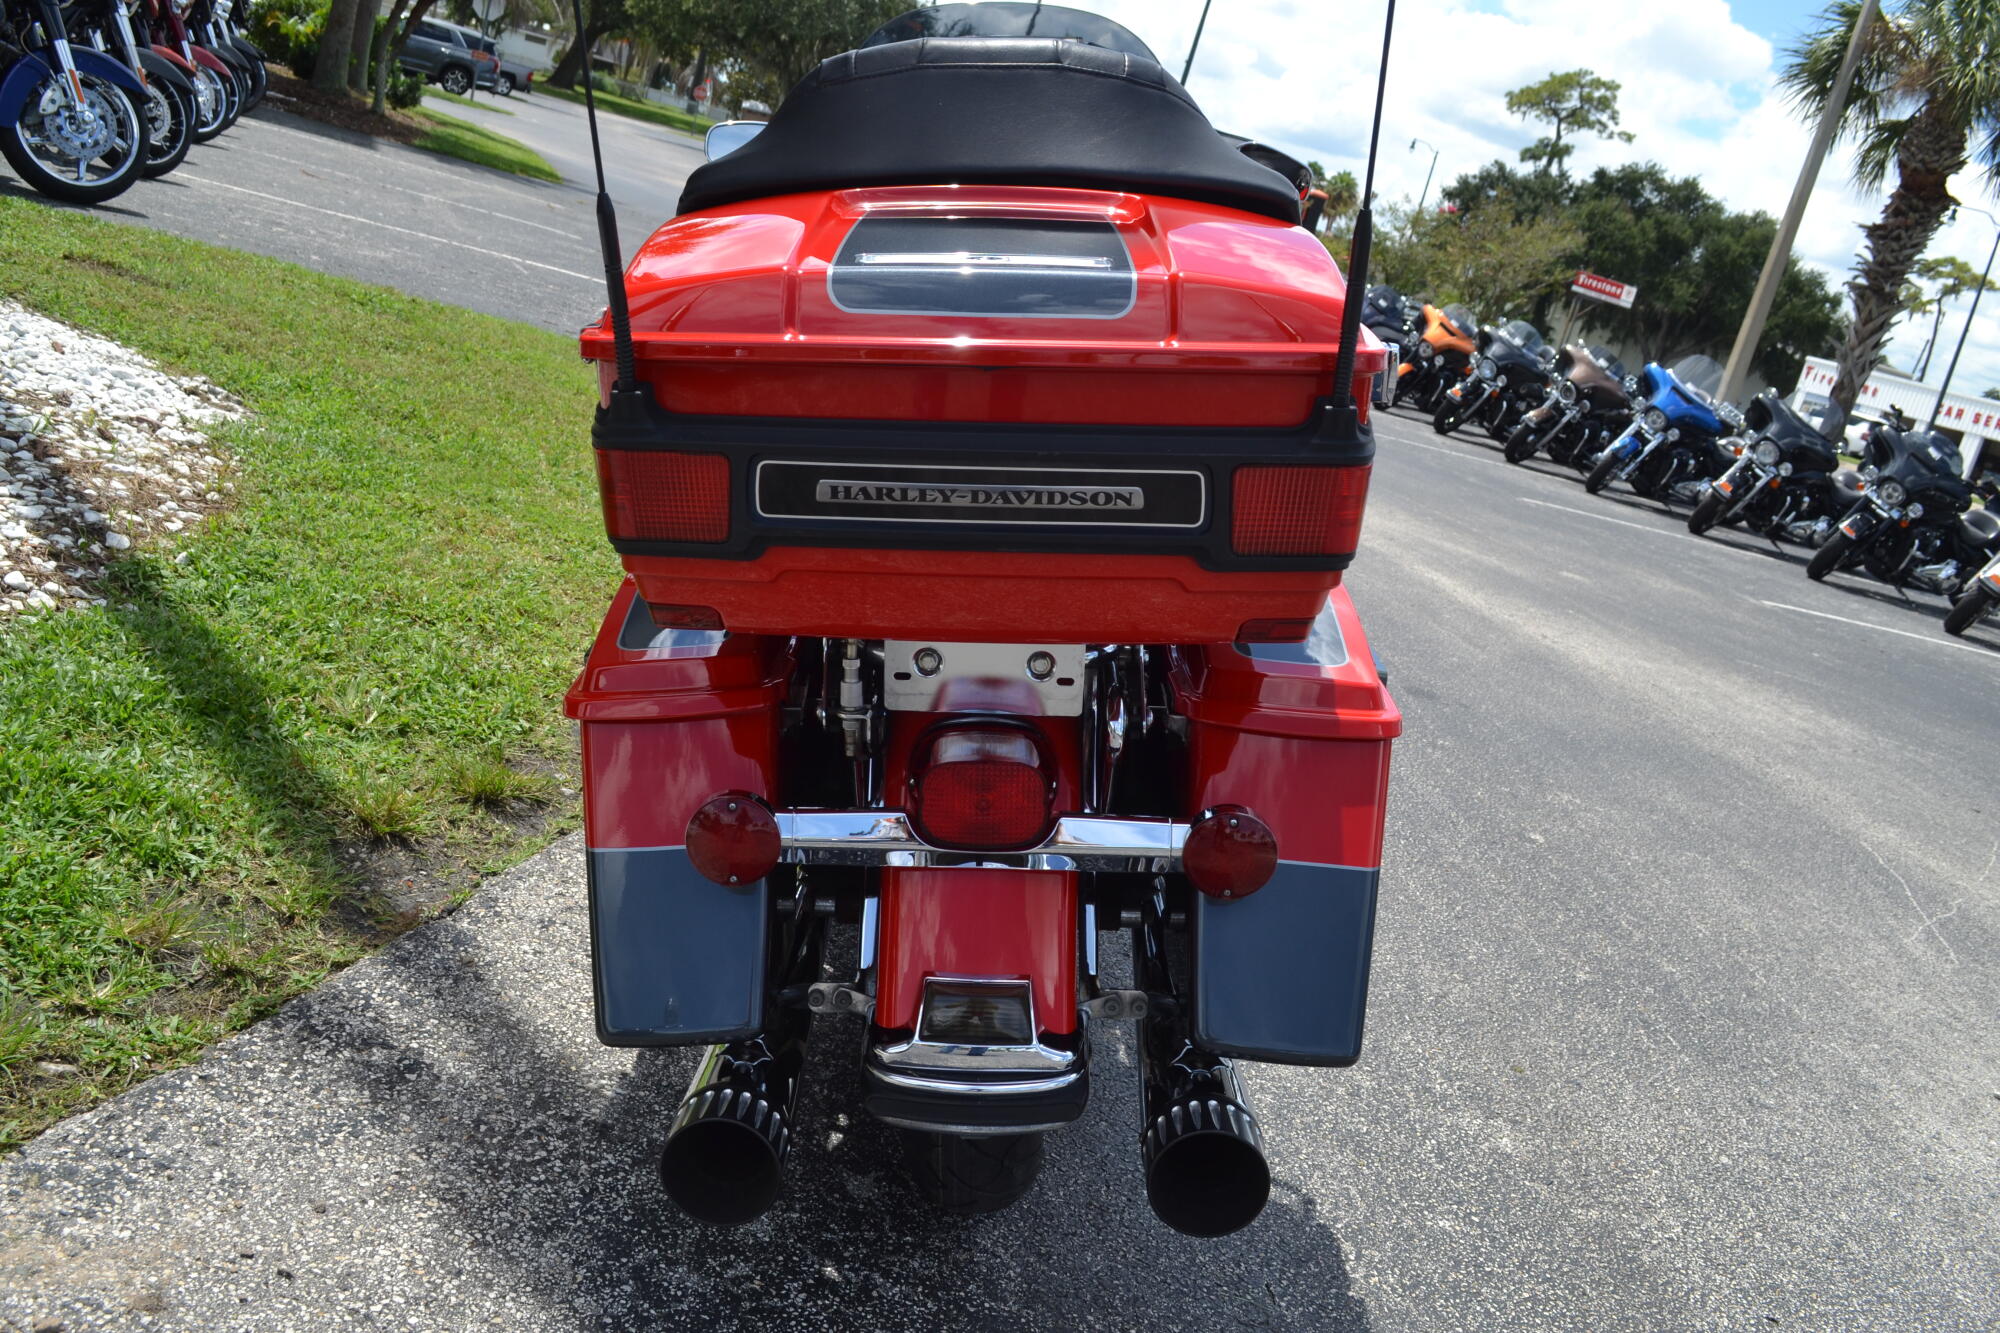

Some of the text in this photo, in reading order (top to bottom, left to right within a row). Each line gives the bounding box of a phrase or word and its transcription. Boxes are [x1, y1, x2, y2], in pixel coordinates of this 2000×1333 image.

[1578, 273, 1622, 296] Firestone
[1805, 365, 1879, 398] Firene
[828, 484, 1134, 507] HARLEY-DAVIDSON
